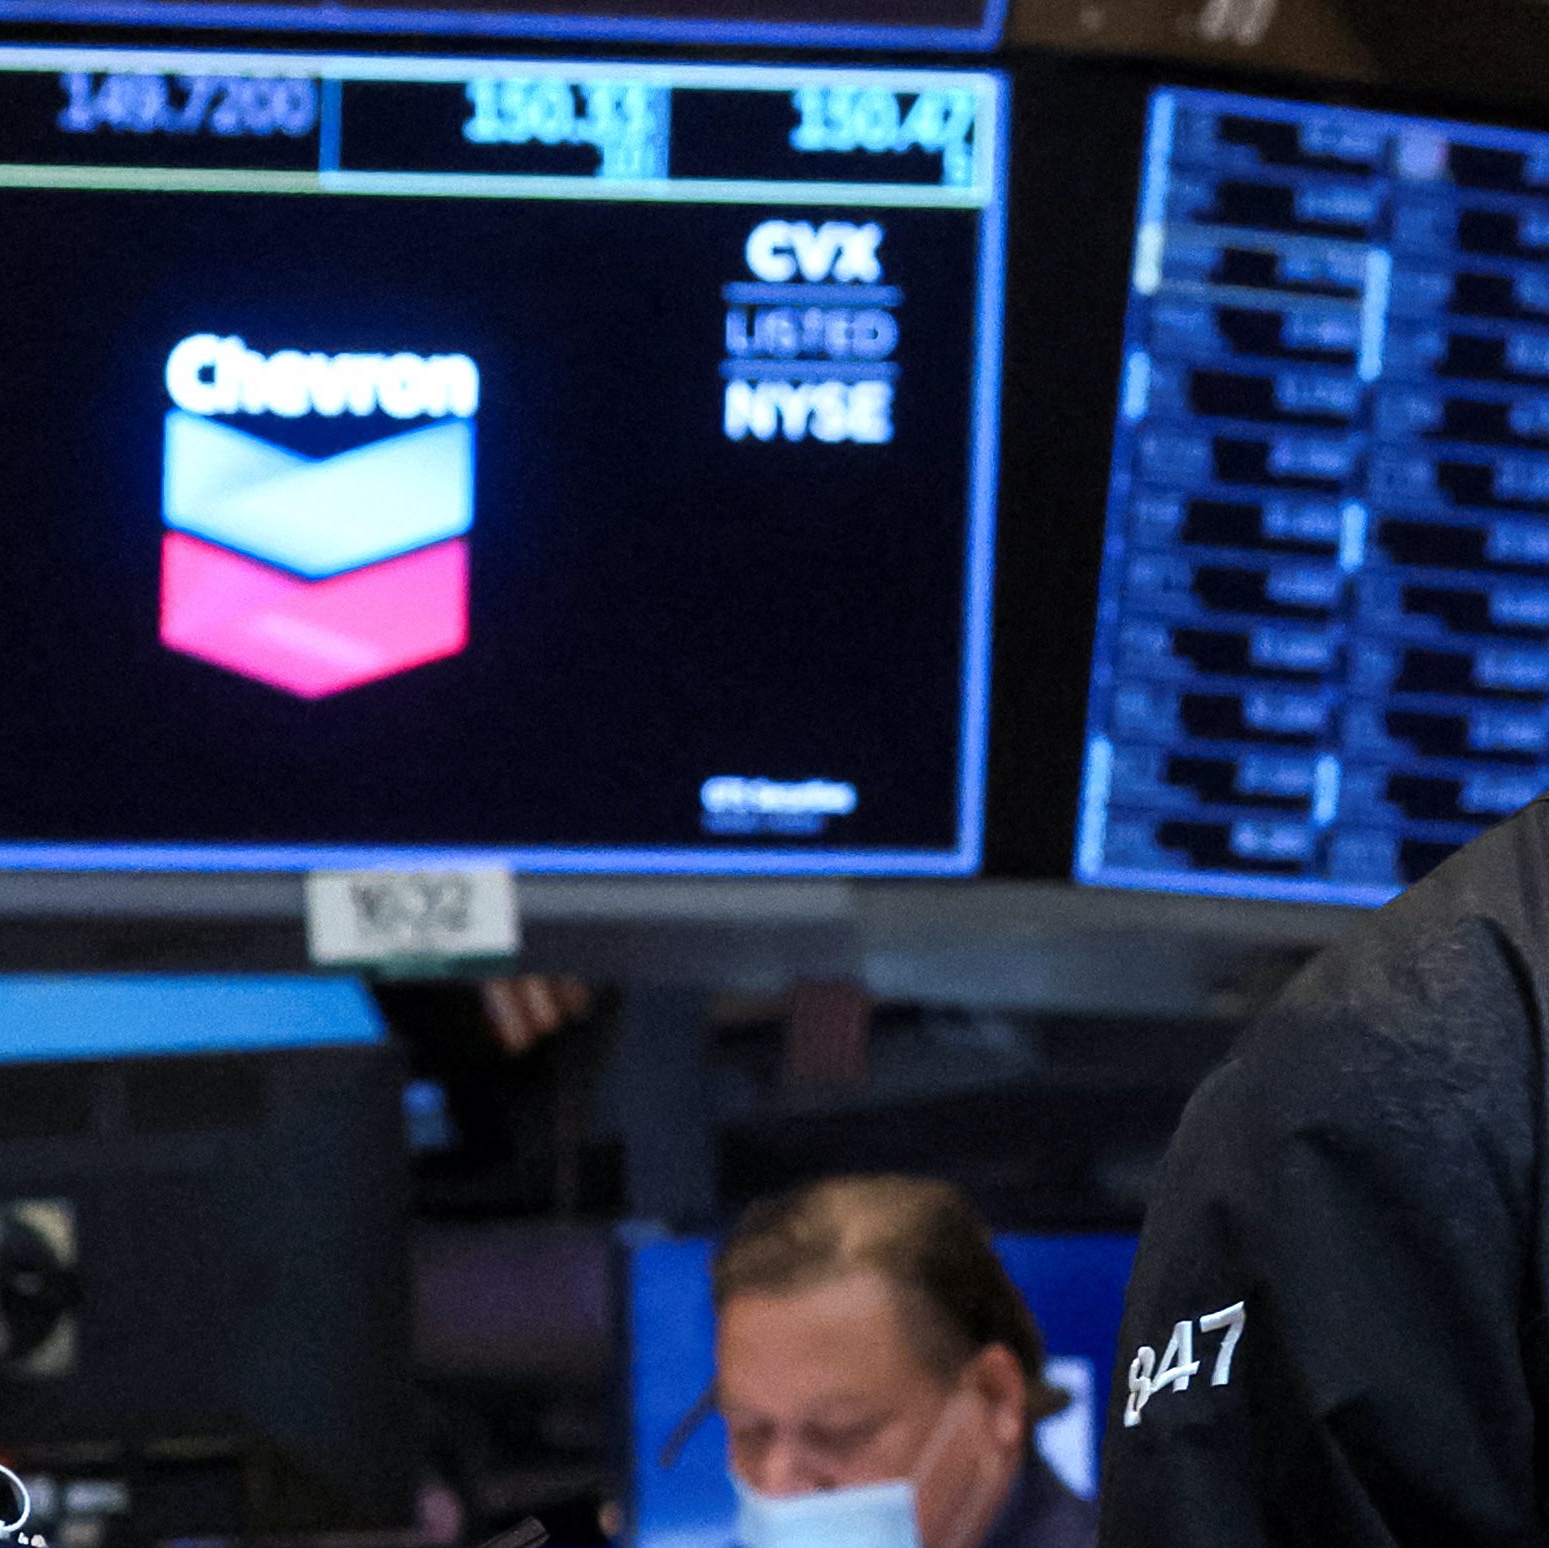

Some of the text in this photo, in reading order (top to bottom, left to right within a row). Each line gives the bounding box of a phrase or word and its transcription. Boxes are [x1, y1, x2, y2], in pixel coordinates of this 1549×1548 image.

[745, 219, 885, 282] CVX
[725, 307, 899, 358] LISTED
[164, 332, 480, 420] Chevron
[723, 380, 895, 443] NYSE
[1123, 1300, 1246, 1428] 847
